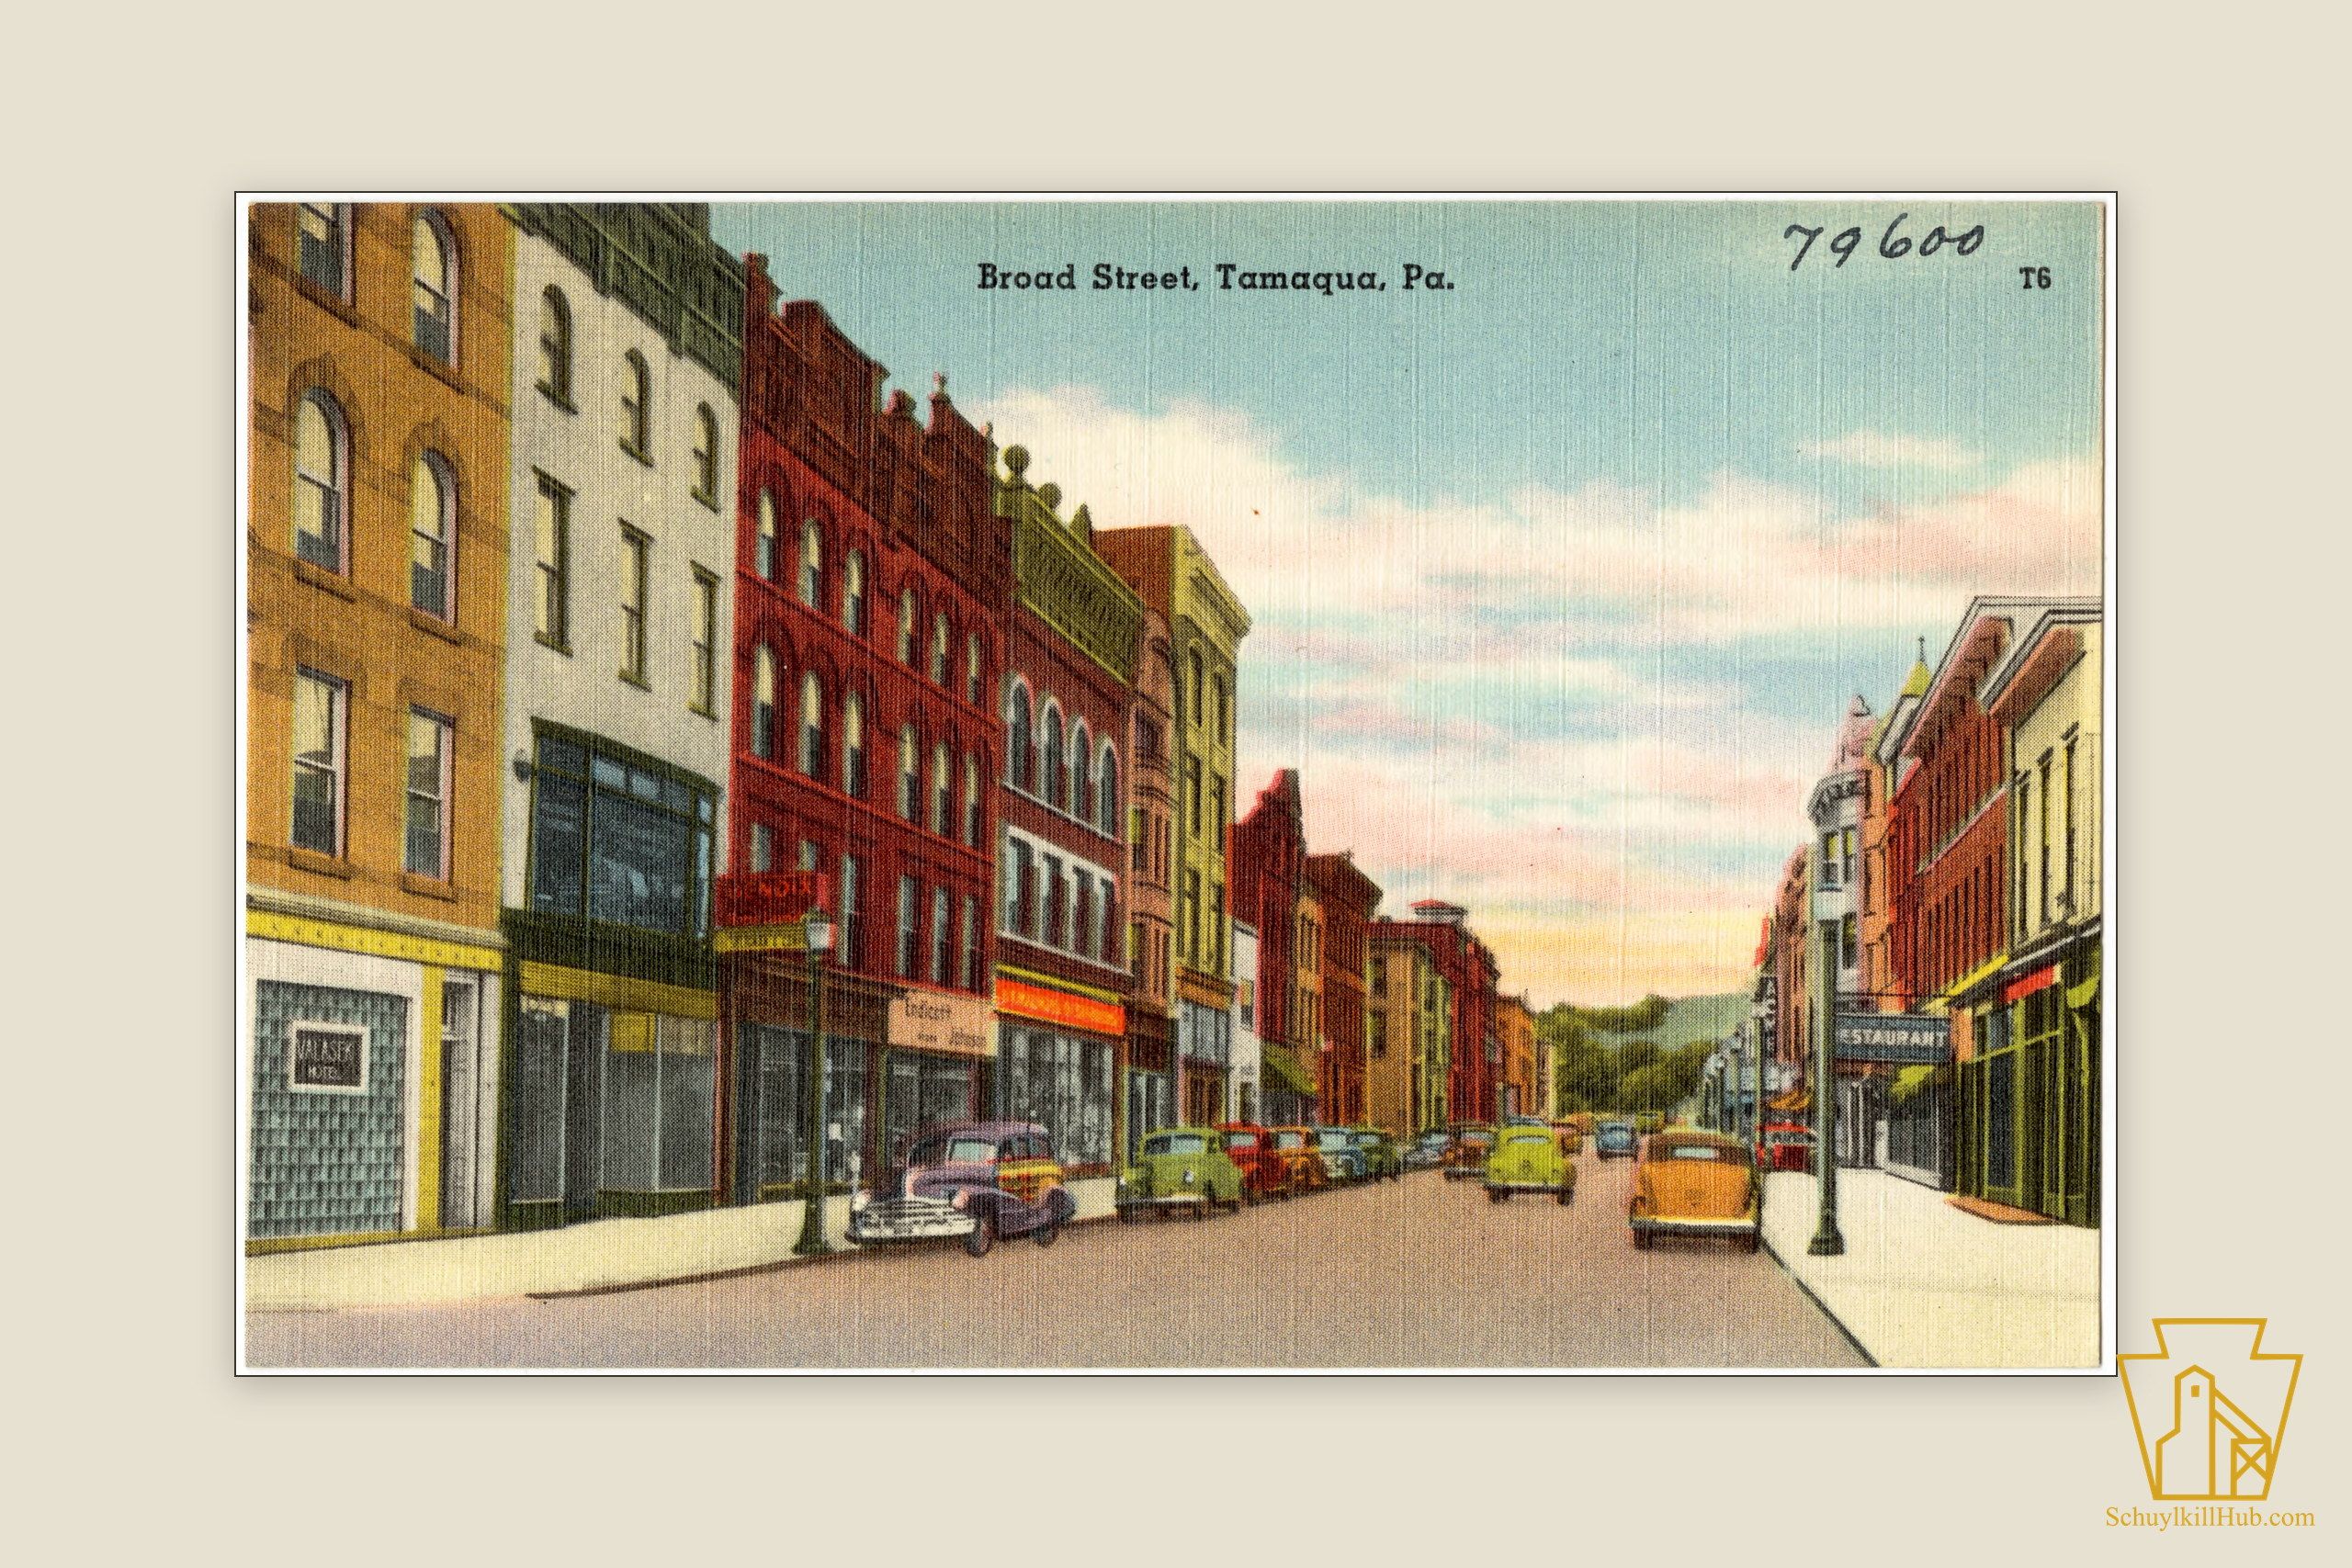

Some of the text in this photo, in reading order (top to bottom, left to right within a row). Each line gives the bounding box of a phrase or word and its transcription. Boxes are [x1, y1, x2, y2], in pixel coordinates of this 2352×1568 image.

[1783, 212, 1984, 271] 79600
[904, 998, 952, 1021] Endicott
[1838, 1028, 1948, 1048] ESTAURANT
